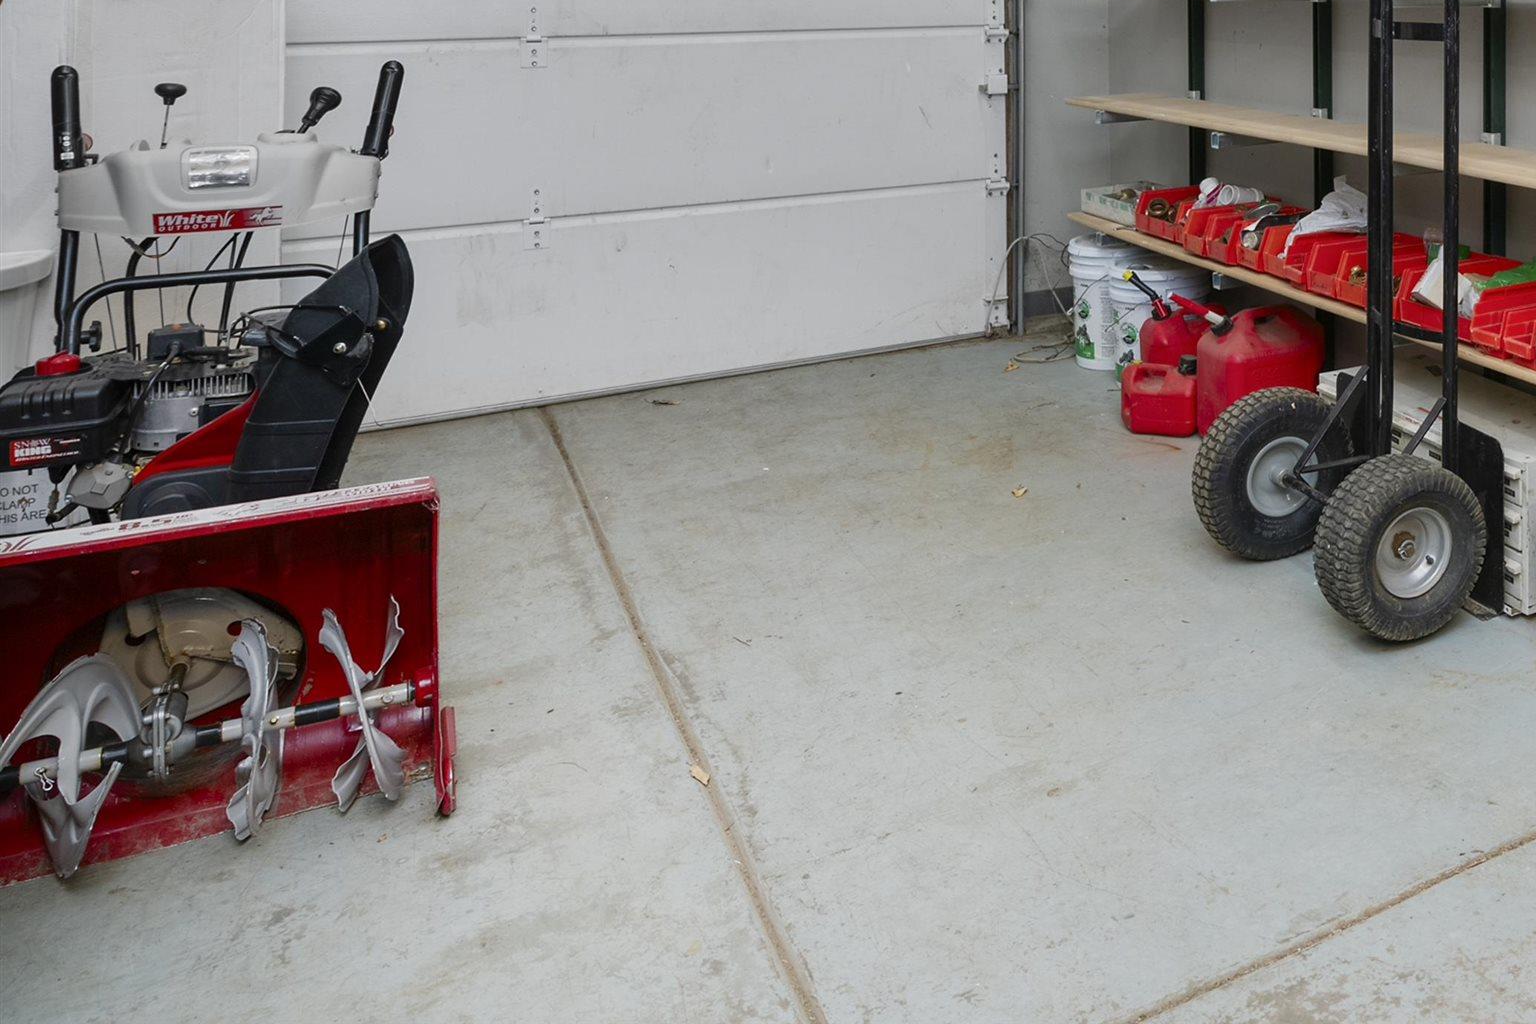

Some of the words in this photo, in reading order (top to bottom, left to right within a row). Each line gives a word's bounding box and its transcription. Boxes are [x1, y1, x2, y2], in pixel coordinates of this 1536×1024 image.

[158, 214, 219, 226] White
[158, 223, 217, 232] OUTDOOR
[14, 445, 52, 458] KING
[12, 483, 39, 496] NOT
